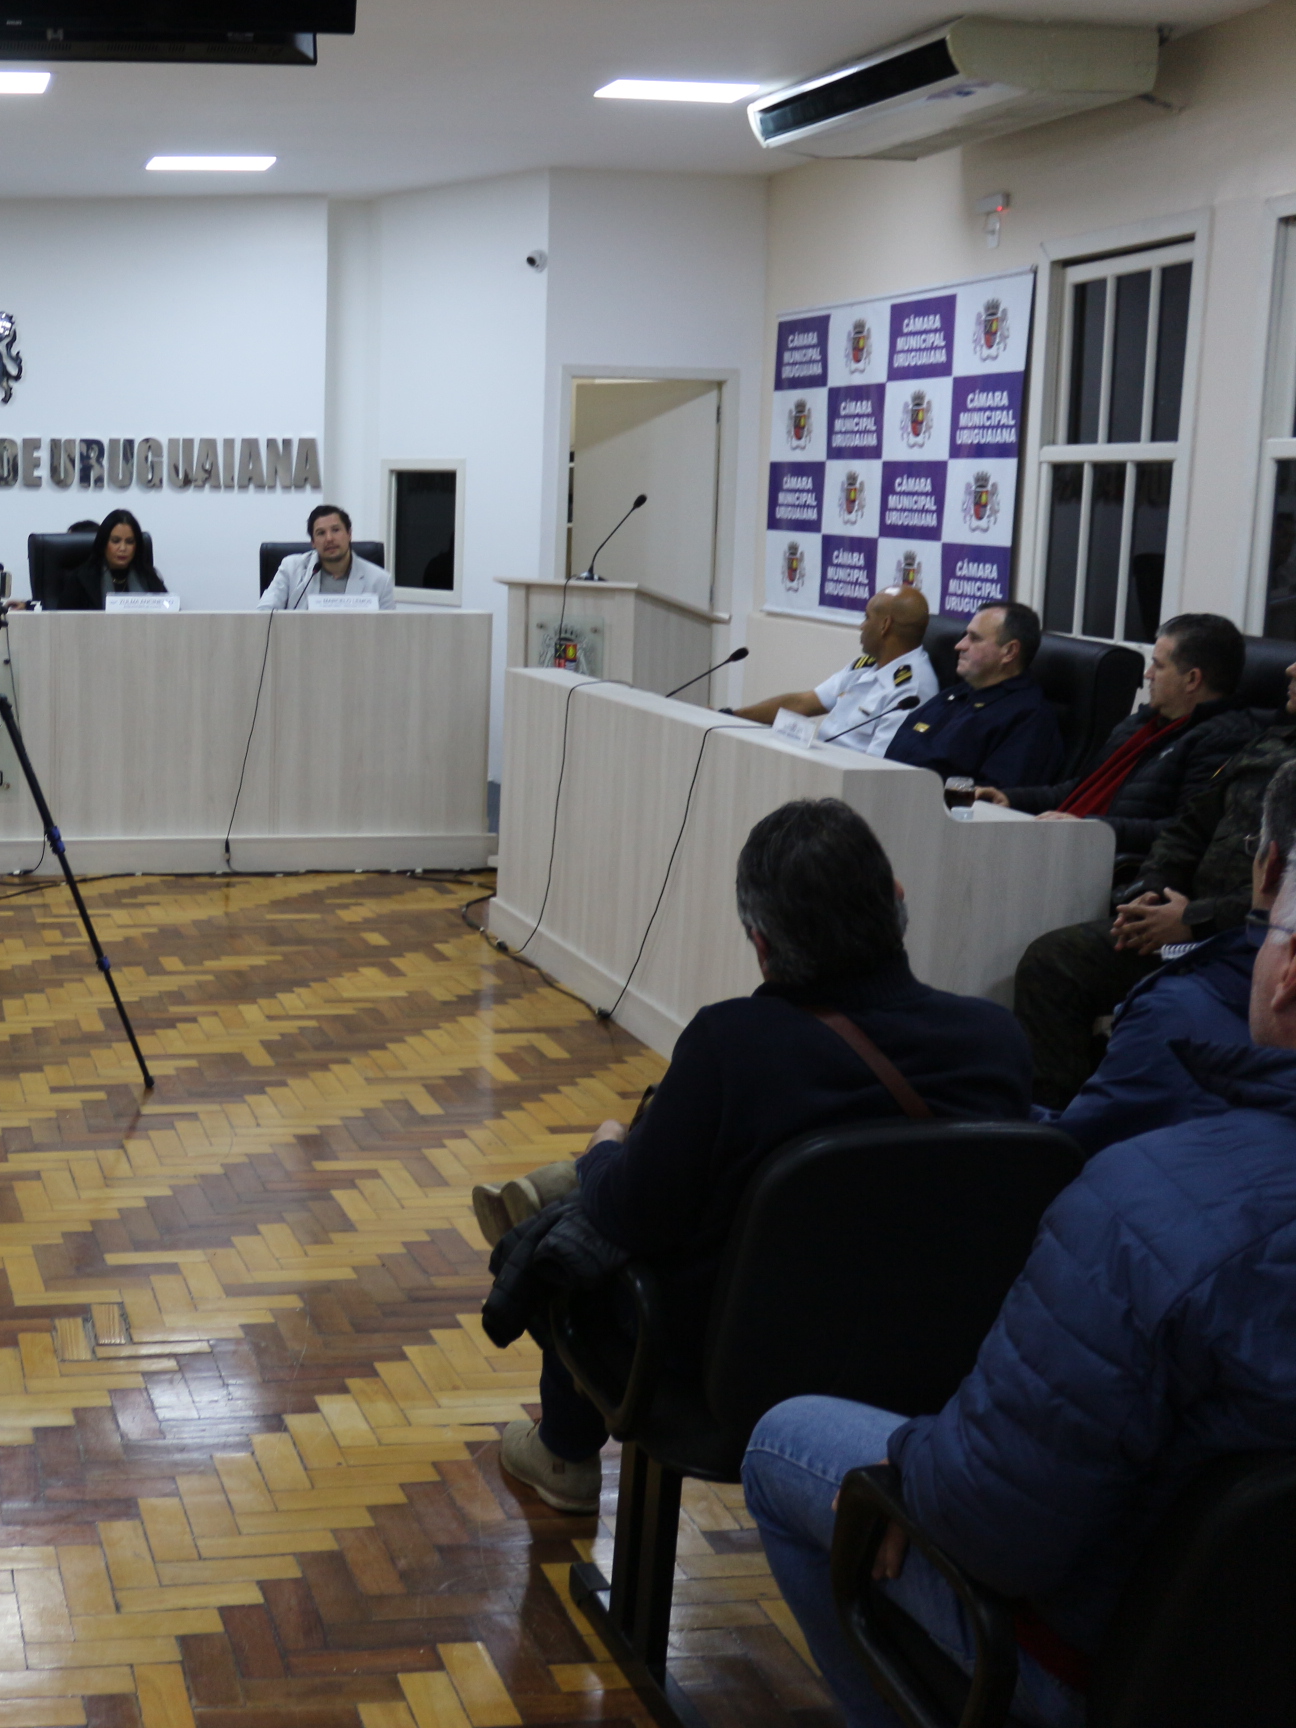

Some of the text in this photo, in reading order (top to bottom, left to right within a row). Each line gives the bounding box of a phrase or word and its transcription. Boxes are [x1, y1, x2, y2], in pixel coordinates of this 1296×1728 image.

[896, 331, 946, 352] MUNICIPAL
[783, 347, 822, 364] MUNICIPAL
[893, 348, 947, 368] URUGUAIANA
[834, 416, 877, 432] MUNICIPAL
[959, 409, 1016, 428] MUNICIPAL
[956, 427, 1016, 445] URUGUAIANA
[49, 437, 322, 489] URUGUAIANA
[778, 491, 817, 506] MUNICIPAL
[888, 494, 937, 511] MUNICIPAL
[885, 510, 937, 528] URUGUAIANA
[827, 565, 869, 585] MUNICIPAL
[948, 578, 1003, 600] MUNICIPAL
